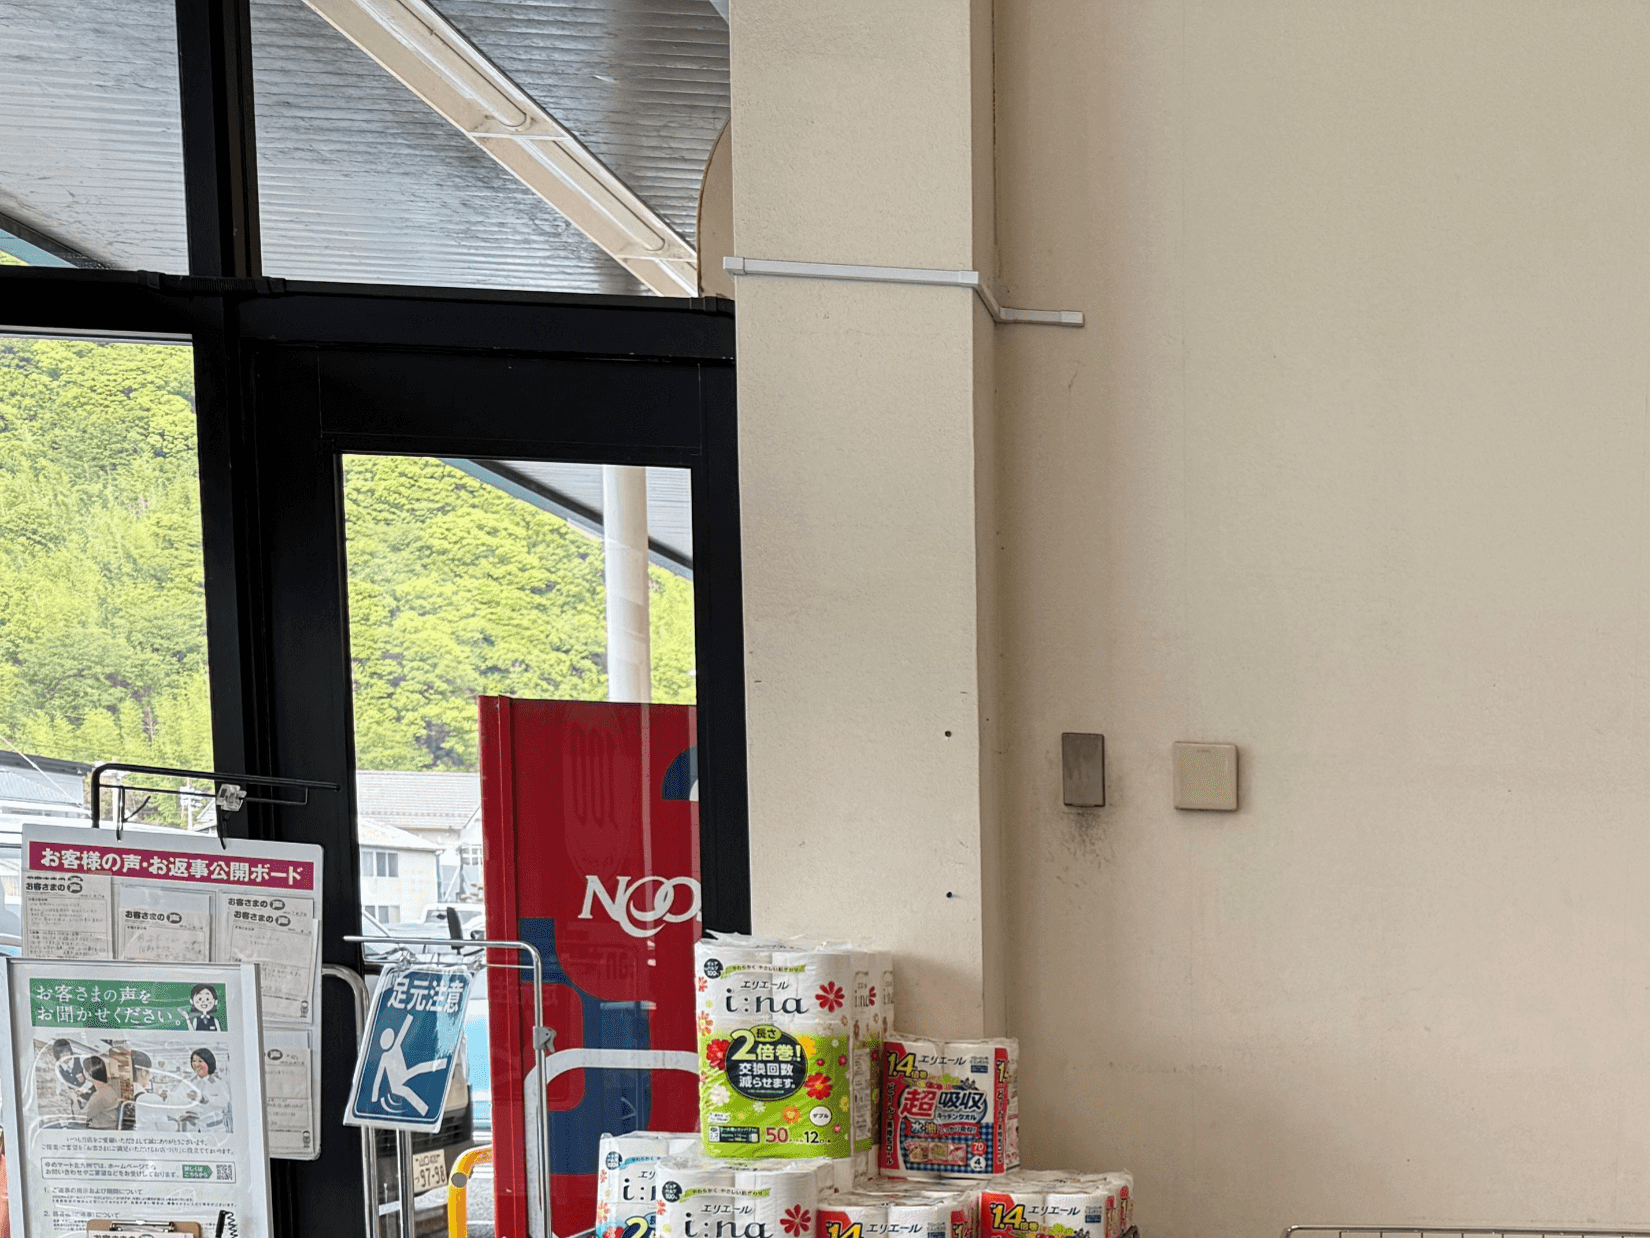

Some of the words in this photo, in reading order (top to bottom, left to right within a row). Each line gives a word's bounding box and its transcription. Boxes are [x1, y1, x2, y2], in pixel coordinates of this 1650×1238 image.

[40, 848, 303, 885] お客様の声・お返事公開ボード
[36, 985, 151, 1004] お客さまの声を
[388, 977, 463, 1012] 足元注意
[37, 1005, 181, 1026] お聞かせください。
[755, 1028, 777, 1039] 長さ
[739, 1063, 793, 1075] 交換回数
[739, 1076, 796, 1088] 減らせます。
[1027, 1206, 1081, 1216] エリエール
[866, 1223, 922, 1234] エリエール
